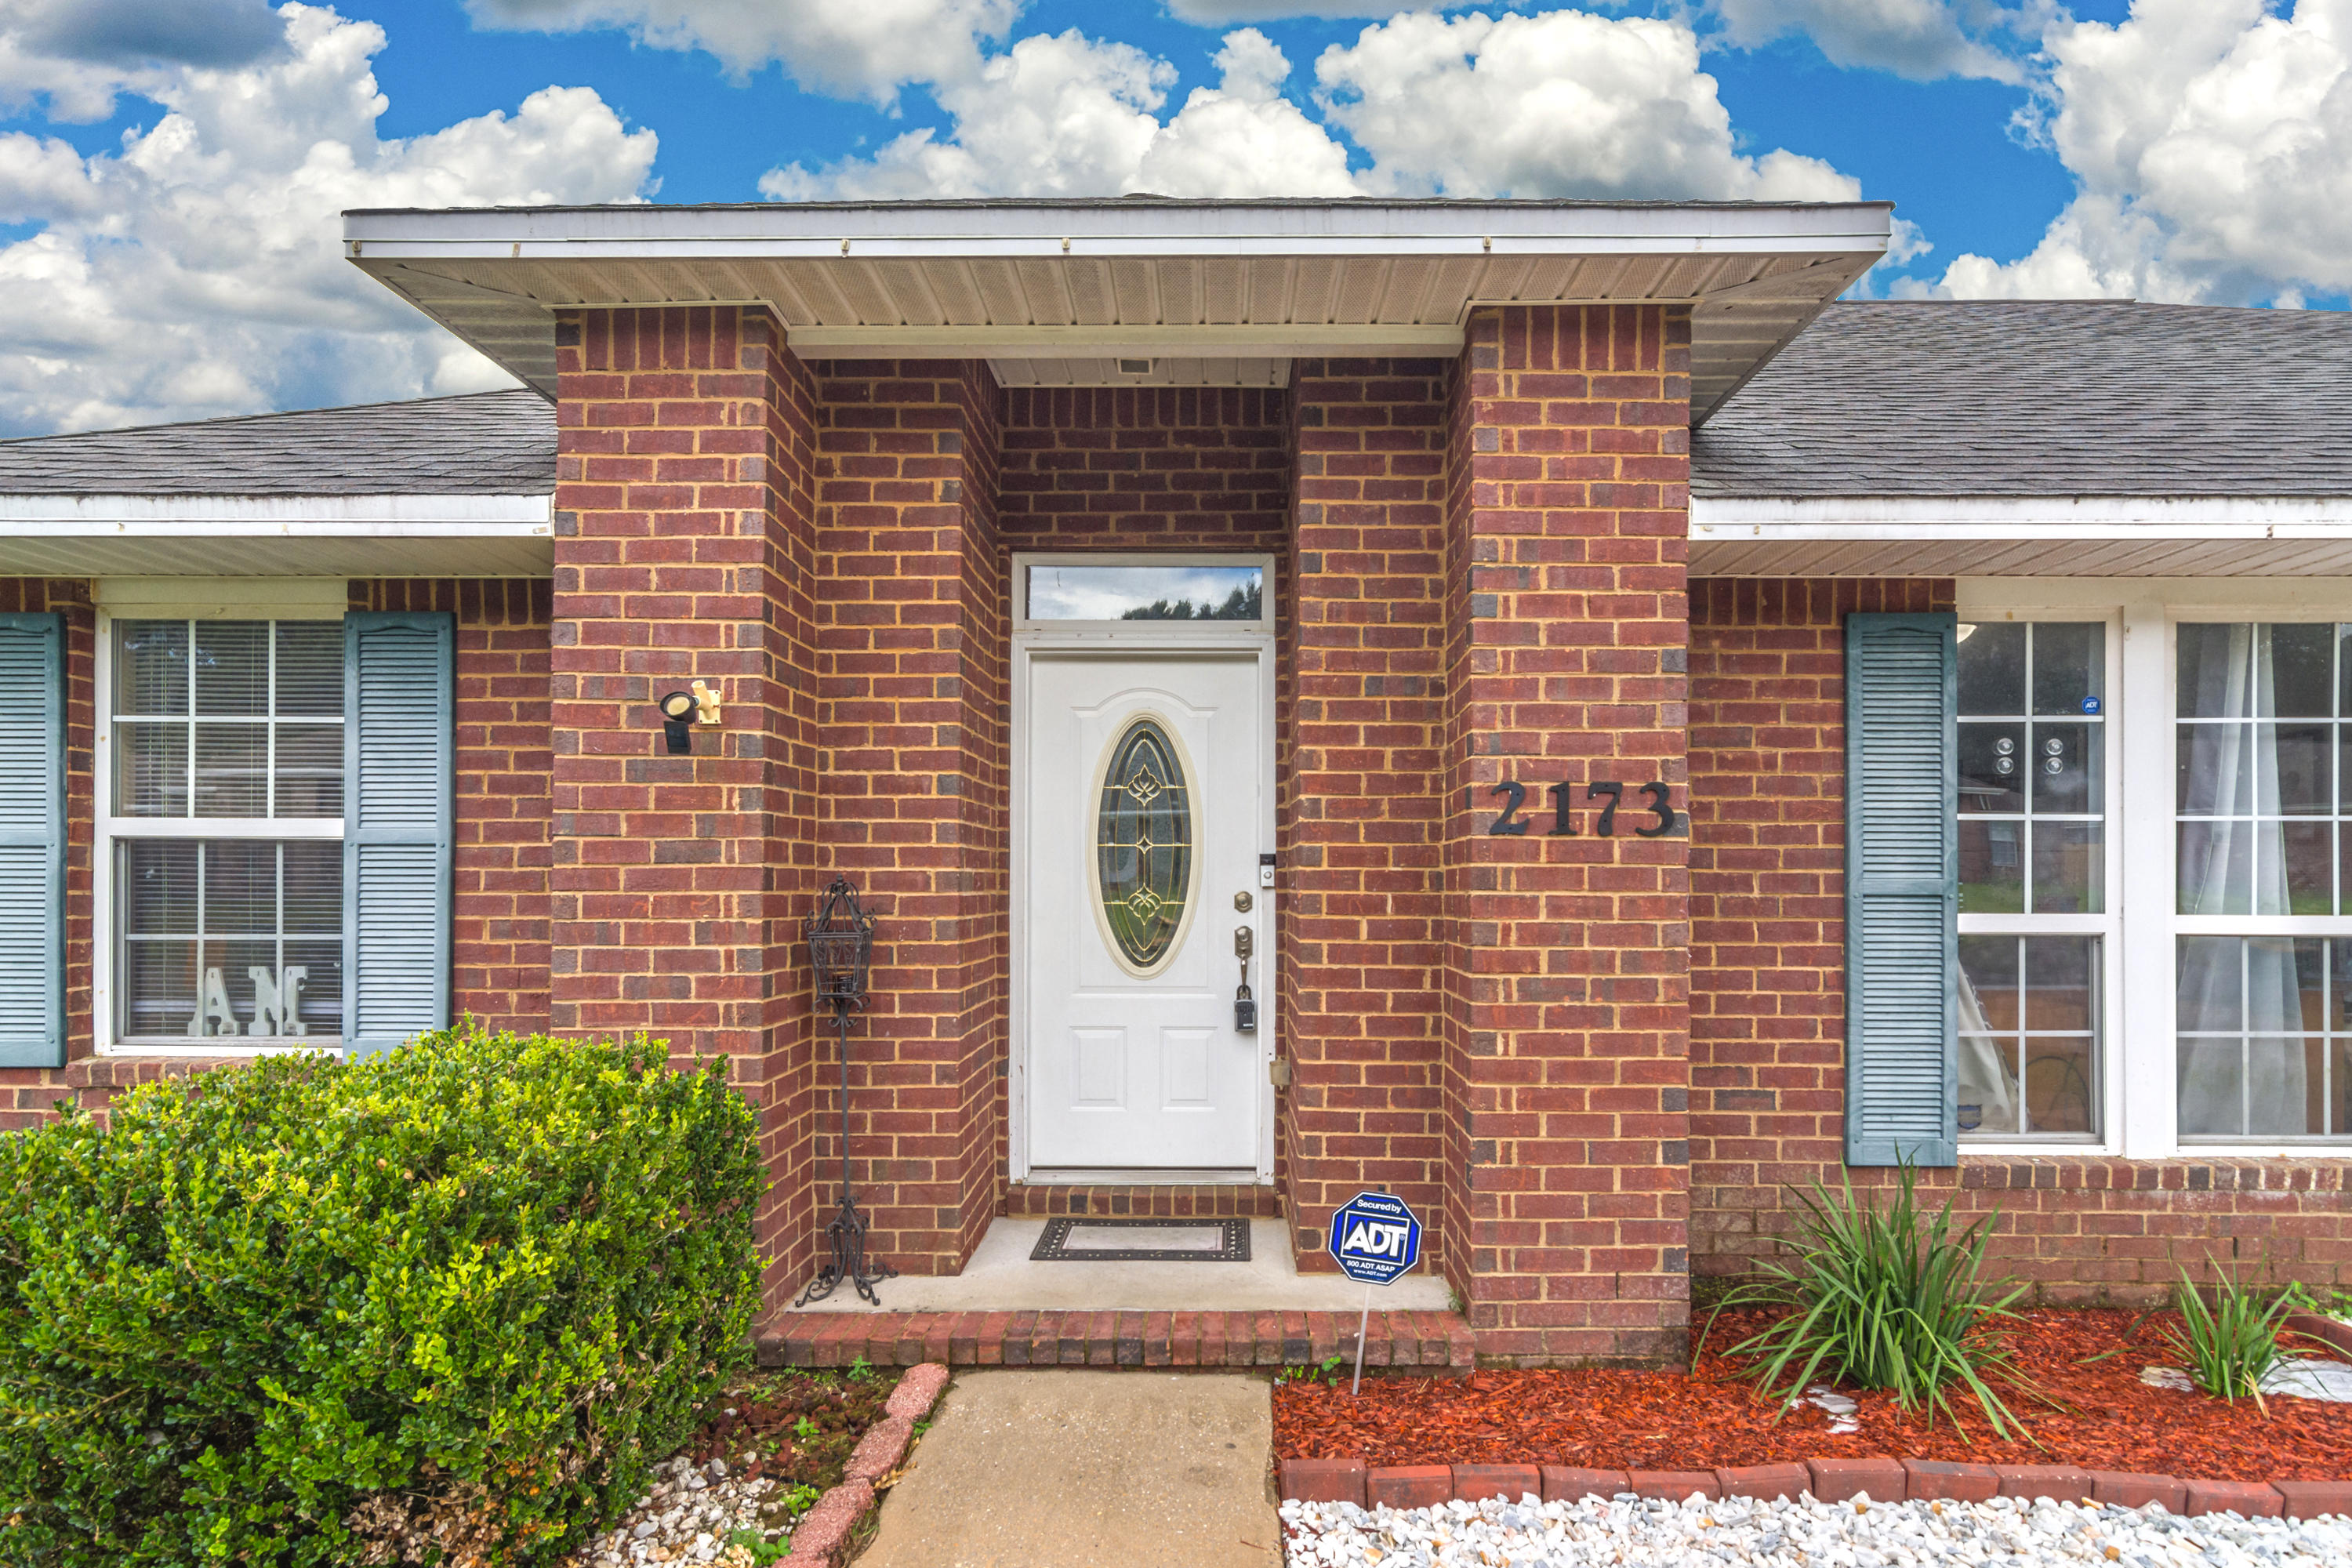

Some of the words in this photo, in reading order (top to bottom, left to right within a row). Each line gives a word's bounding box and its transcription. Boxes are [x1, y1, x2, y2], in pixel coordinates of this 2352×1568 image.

[1489, 781, 1675, 837] 2173
[1357, 1199, 1391, 1211] Secured
[1391, 1203, 1402, 1214] by
[1343, 1221, 1407, 1257] ADT
